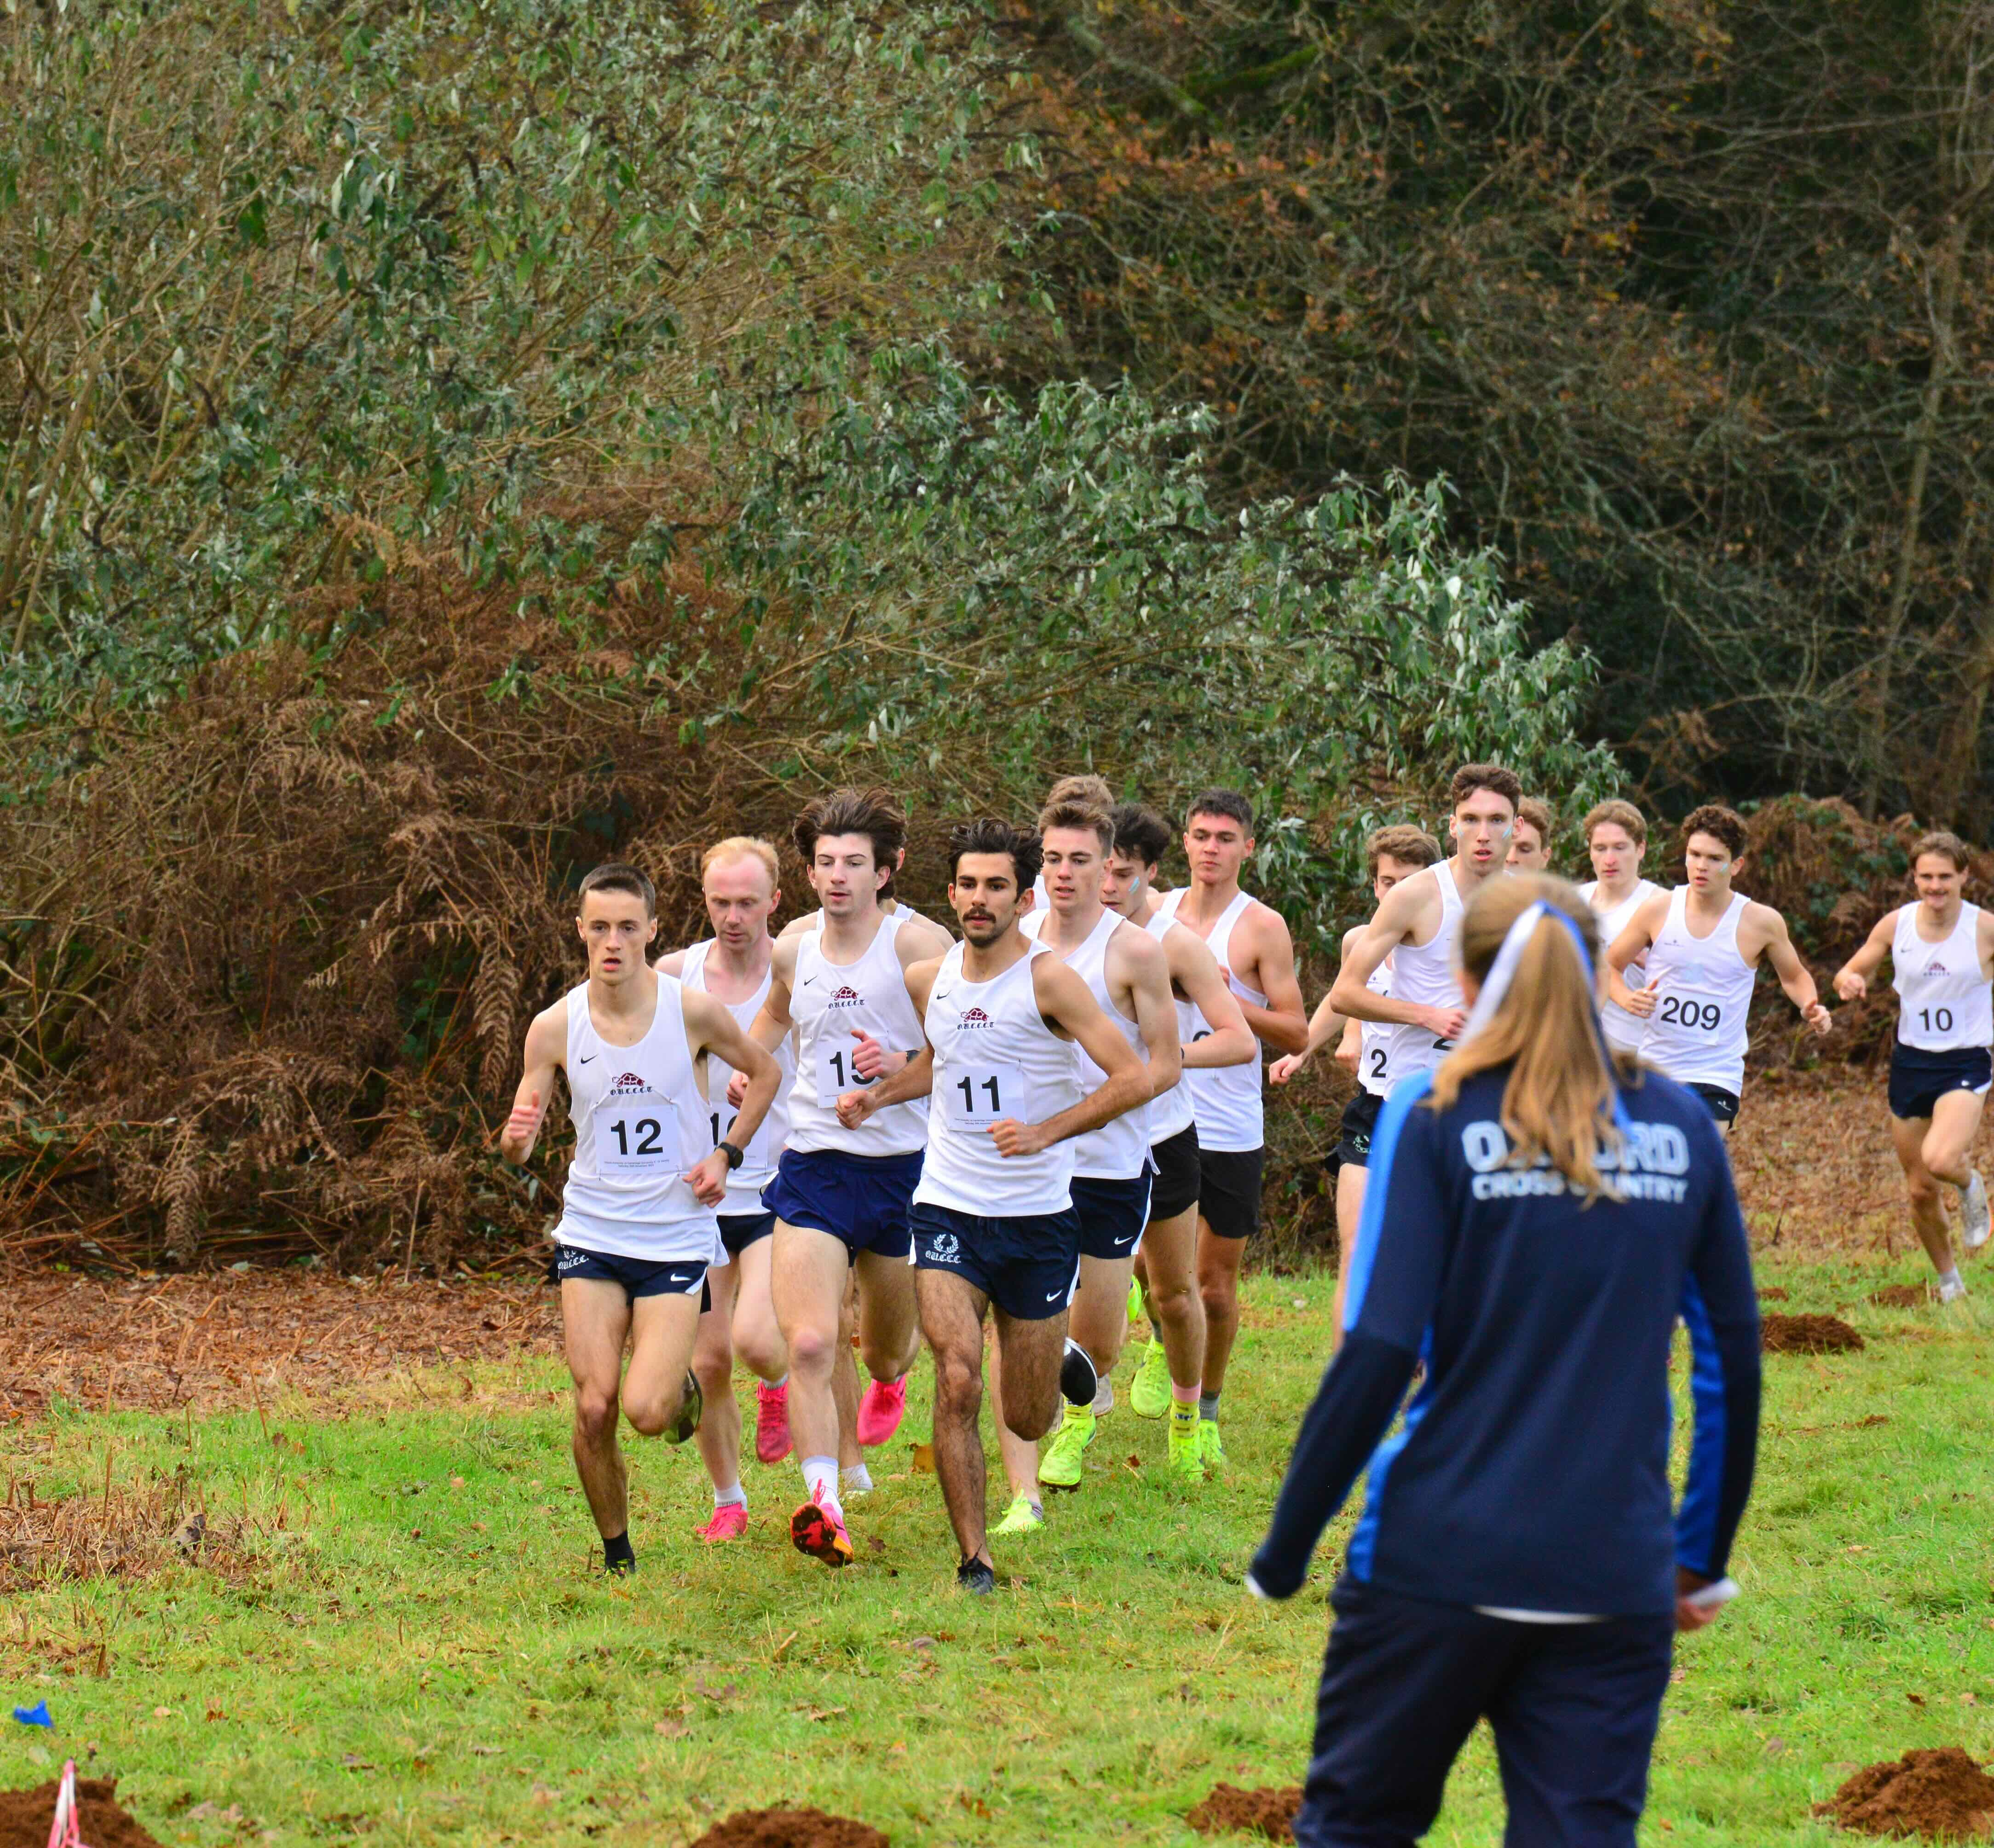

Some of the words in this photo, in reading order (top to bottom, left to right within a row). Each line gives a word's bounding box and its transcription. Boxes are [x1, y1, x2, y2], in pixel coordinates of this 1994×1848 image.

[1660, 996, 1721, 1031] 209
[1919, 1008, 1953, 1032] 10
[957, 1075, 1001, 1112] 11
[611, 1118, 663, 1155] 12
[710, 1112, 738, 1146] 1
